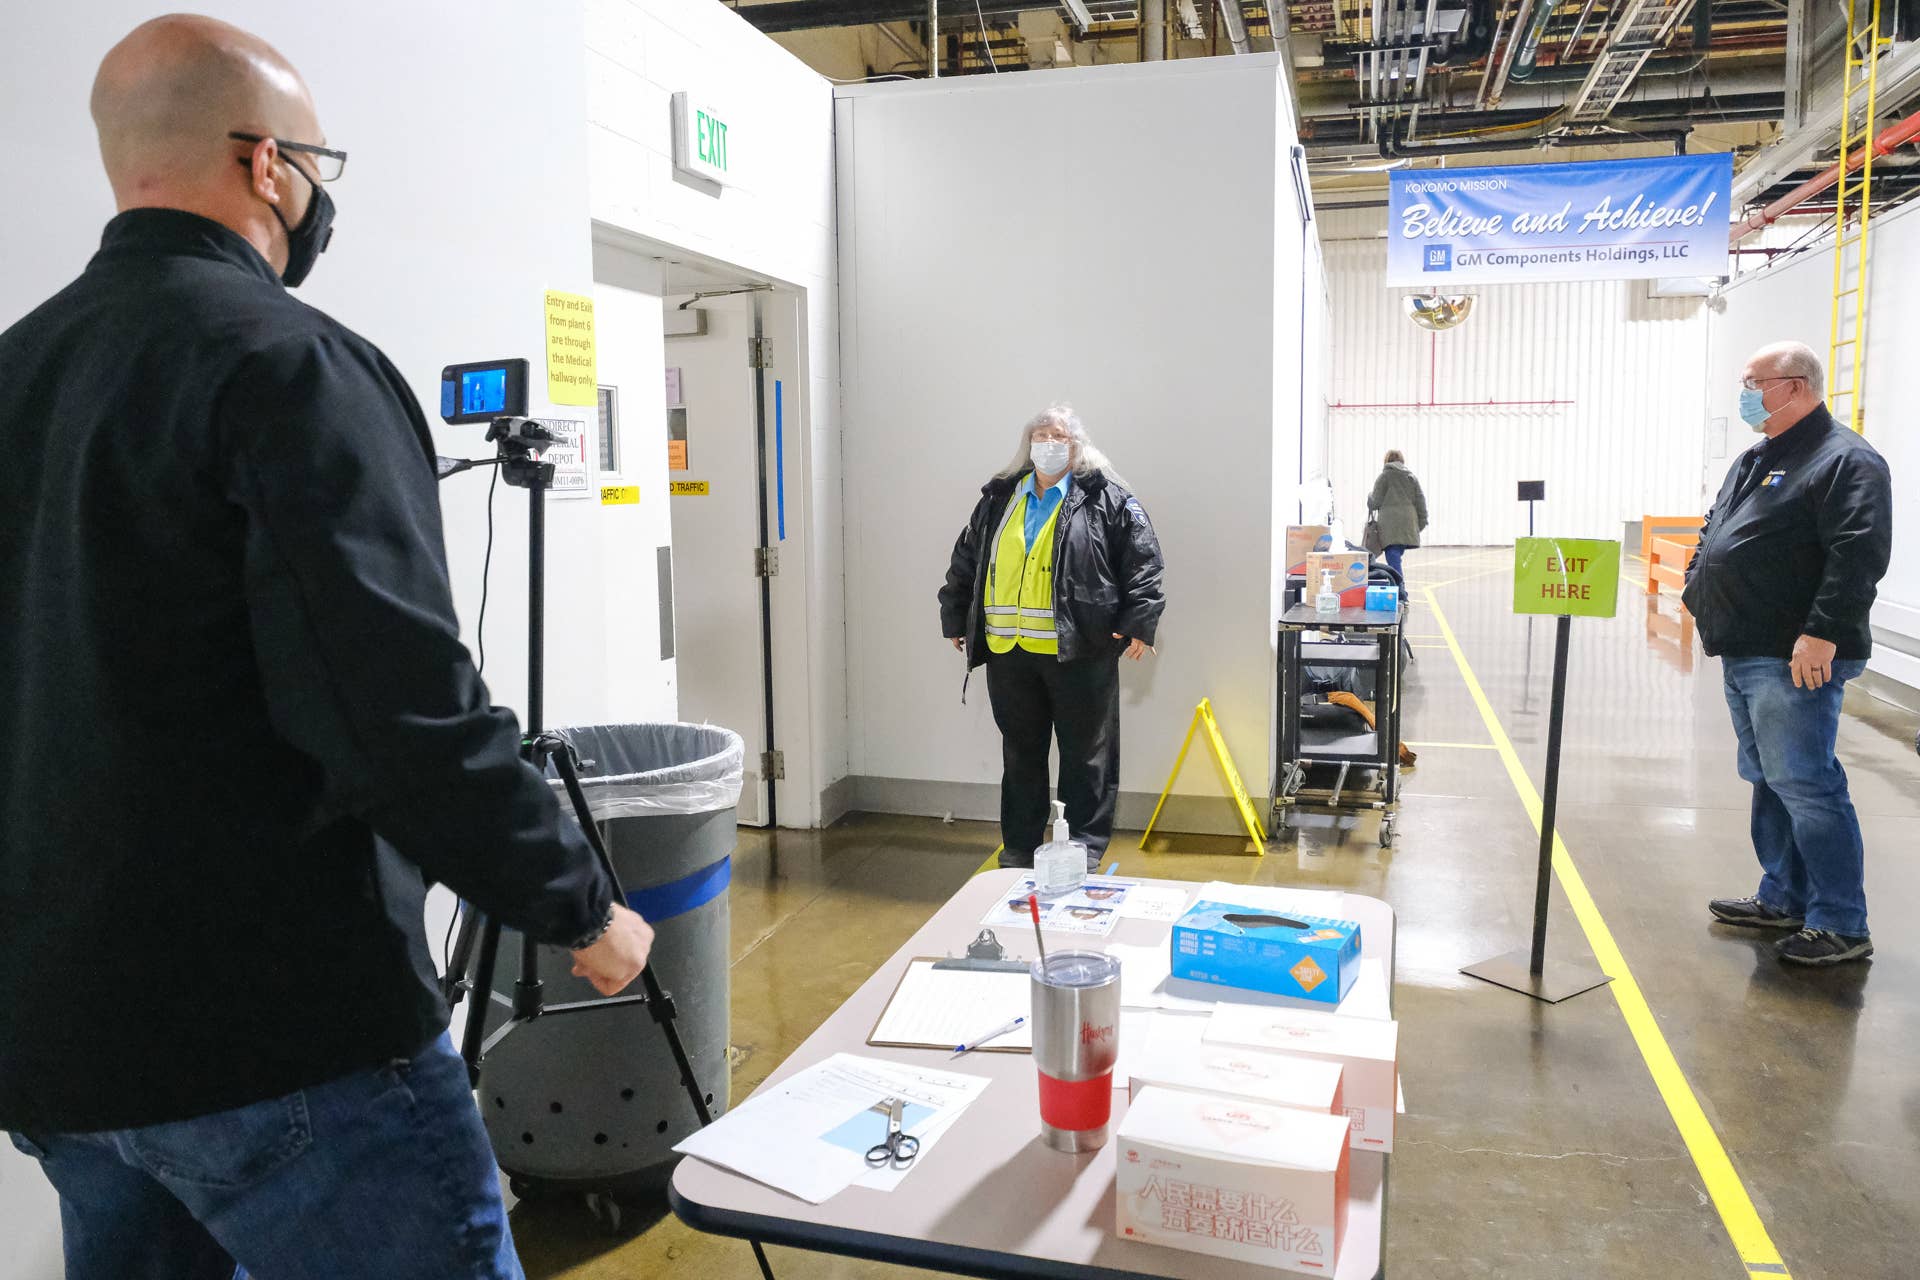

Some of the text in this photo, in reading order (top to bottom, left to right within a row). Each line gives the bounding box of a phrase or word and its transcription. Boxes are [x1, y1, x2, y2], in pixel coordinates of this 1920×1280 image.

[697, 109, 727, 172] EXIT
[1405, 179, 1507, 193] KOKOMO MISSION
[1402, 191, 1717, 239] Believe and Achieve!
[1429, 249, 1446, 263] GM
[1456, 245, 1689, 267] GM Components Holdings, LLC
[546, 295, 593, 313] Entry and Exit
[549, 314, 591, 331] from plant 6
[551, 335, 591, 351] are through
[552, 353, 592, 367] the Medical
[551, 370, 595, 388] hallway only.
[548, 453, 574, 465] DEPOT
[677, 482, 705, 492] TRAFFIC
[1546, 557, 1589, 573] EXIT
[1541, 583, 1591, 600] HERE
